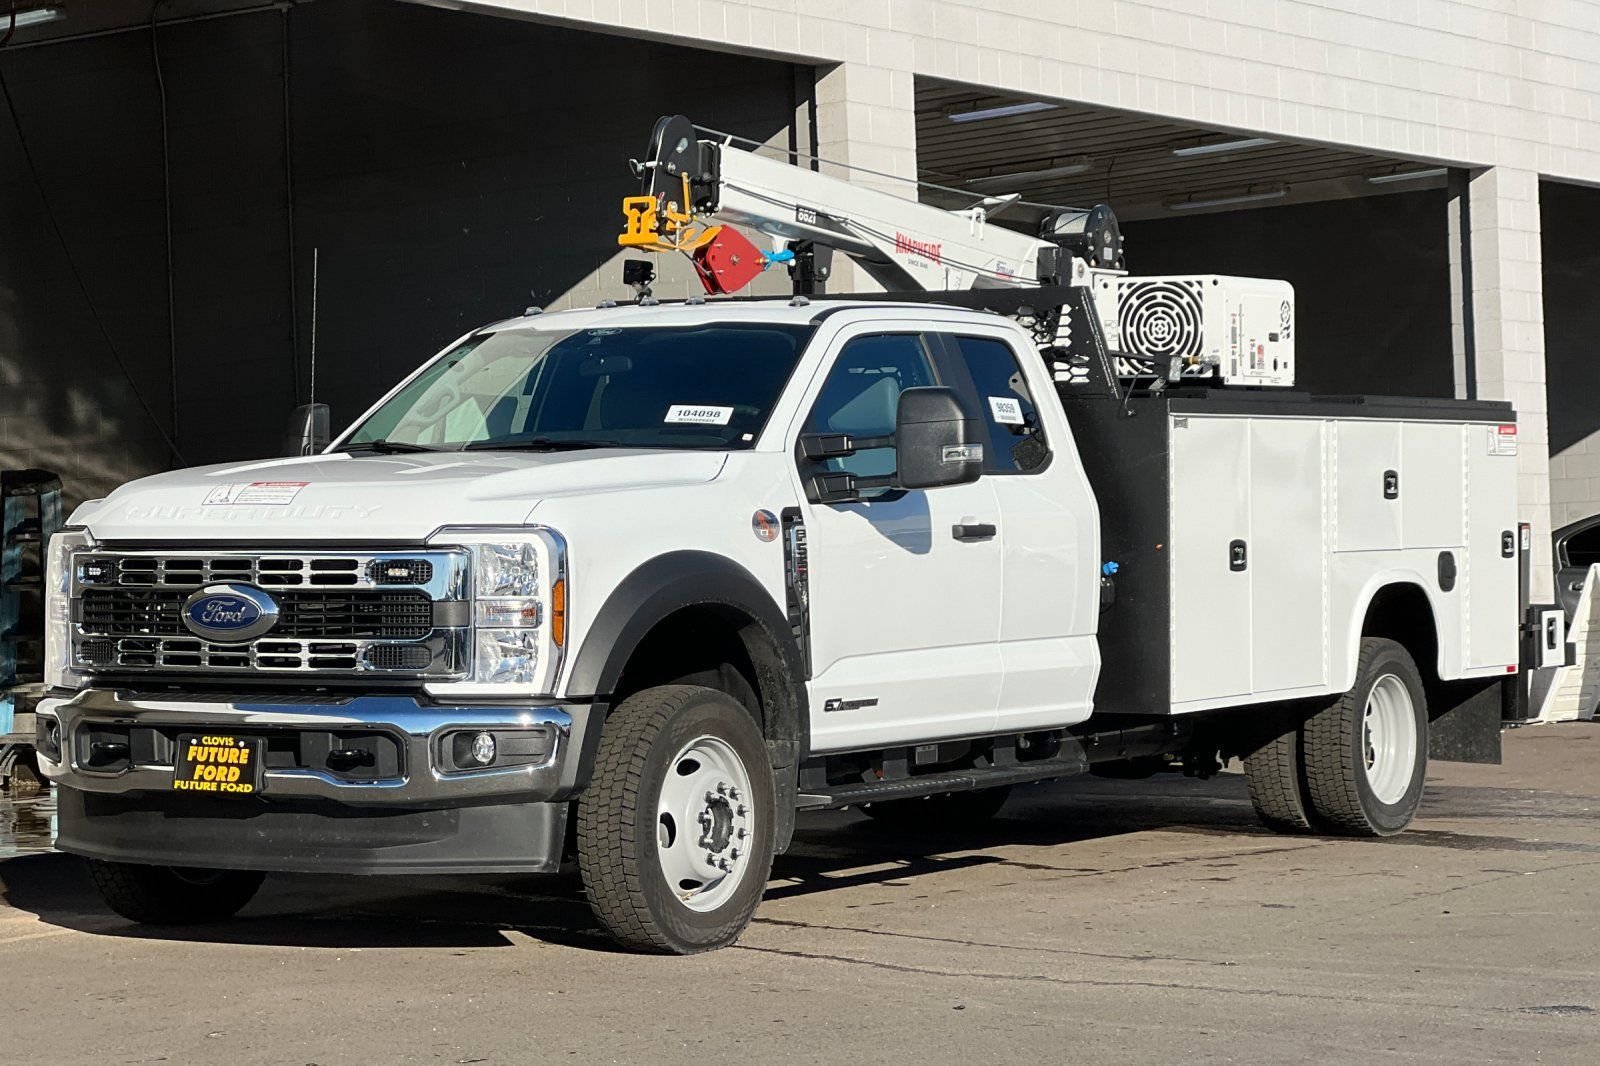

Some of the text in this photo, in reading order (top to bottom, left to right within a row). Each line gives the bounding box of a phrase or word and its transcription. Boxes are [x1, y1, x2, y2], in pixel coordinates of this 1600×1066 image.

[677, 409, 721, 418] 104098
[202, 600, 246, 622] Ford
[201, 736, 235, 746] CLOVIS
[187, 745, 250, 764] FUTURE
[193, 764, 241, 782] FORD
[173, 780, 253, 793] FUTURE FORD
